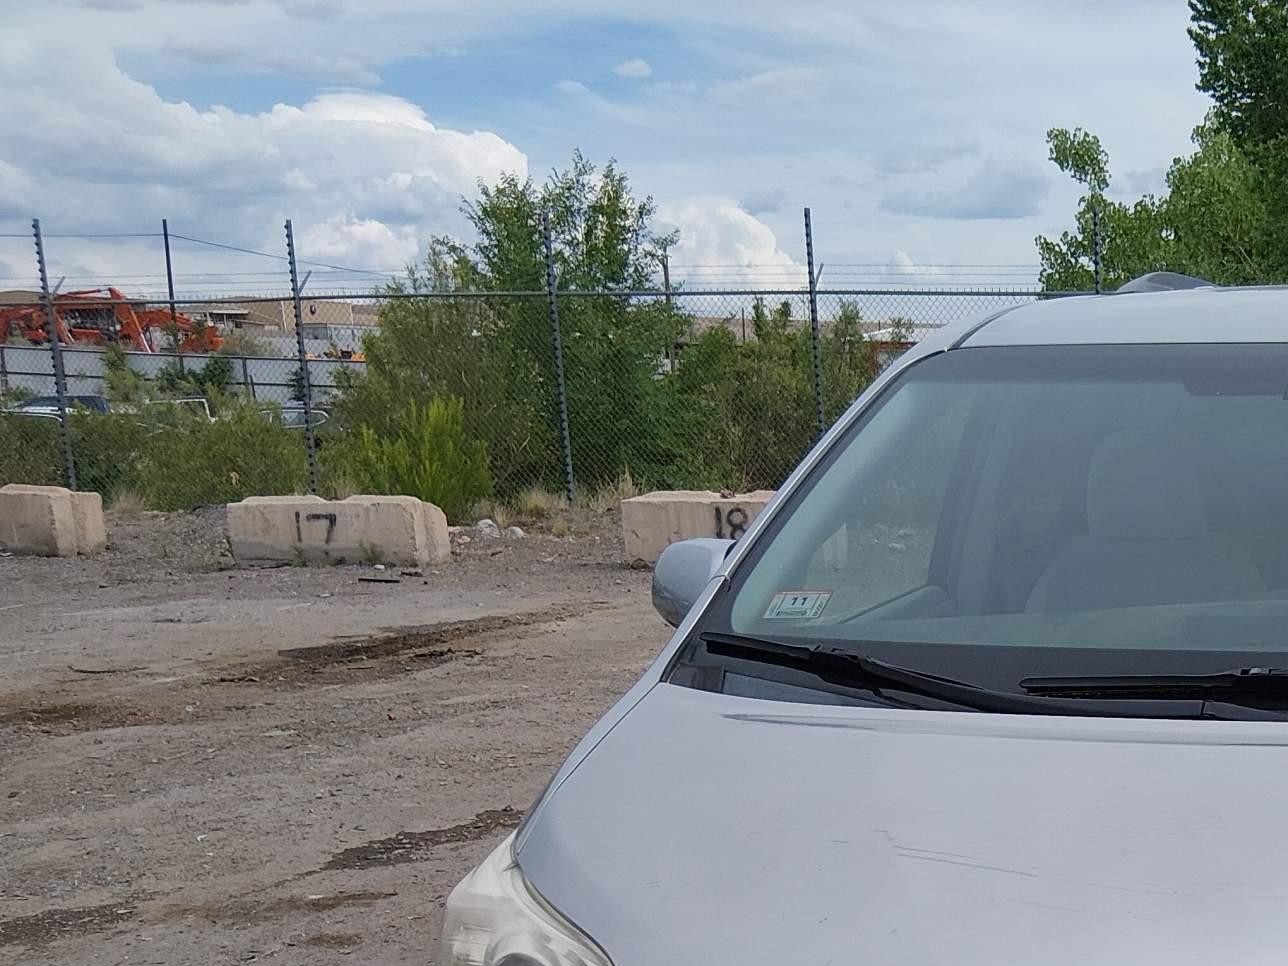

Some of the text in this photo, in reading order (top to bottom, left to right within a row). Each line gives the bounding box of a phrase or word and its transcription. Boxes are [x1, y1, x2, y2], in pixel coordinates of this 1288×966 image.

[294, 511, 337, 545] 17
[714, 505, 748, 539] 18
[790, 597, 809, 606] 11
